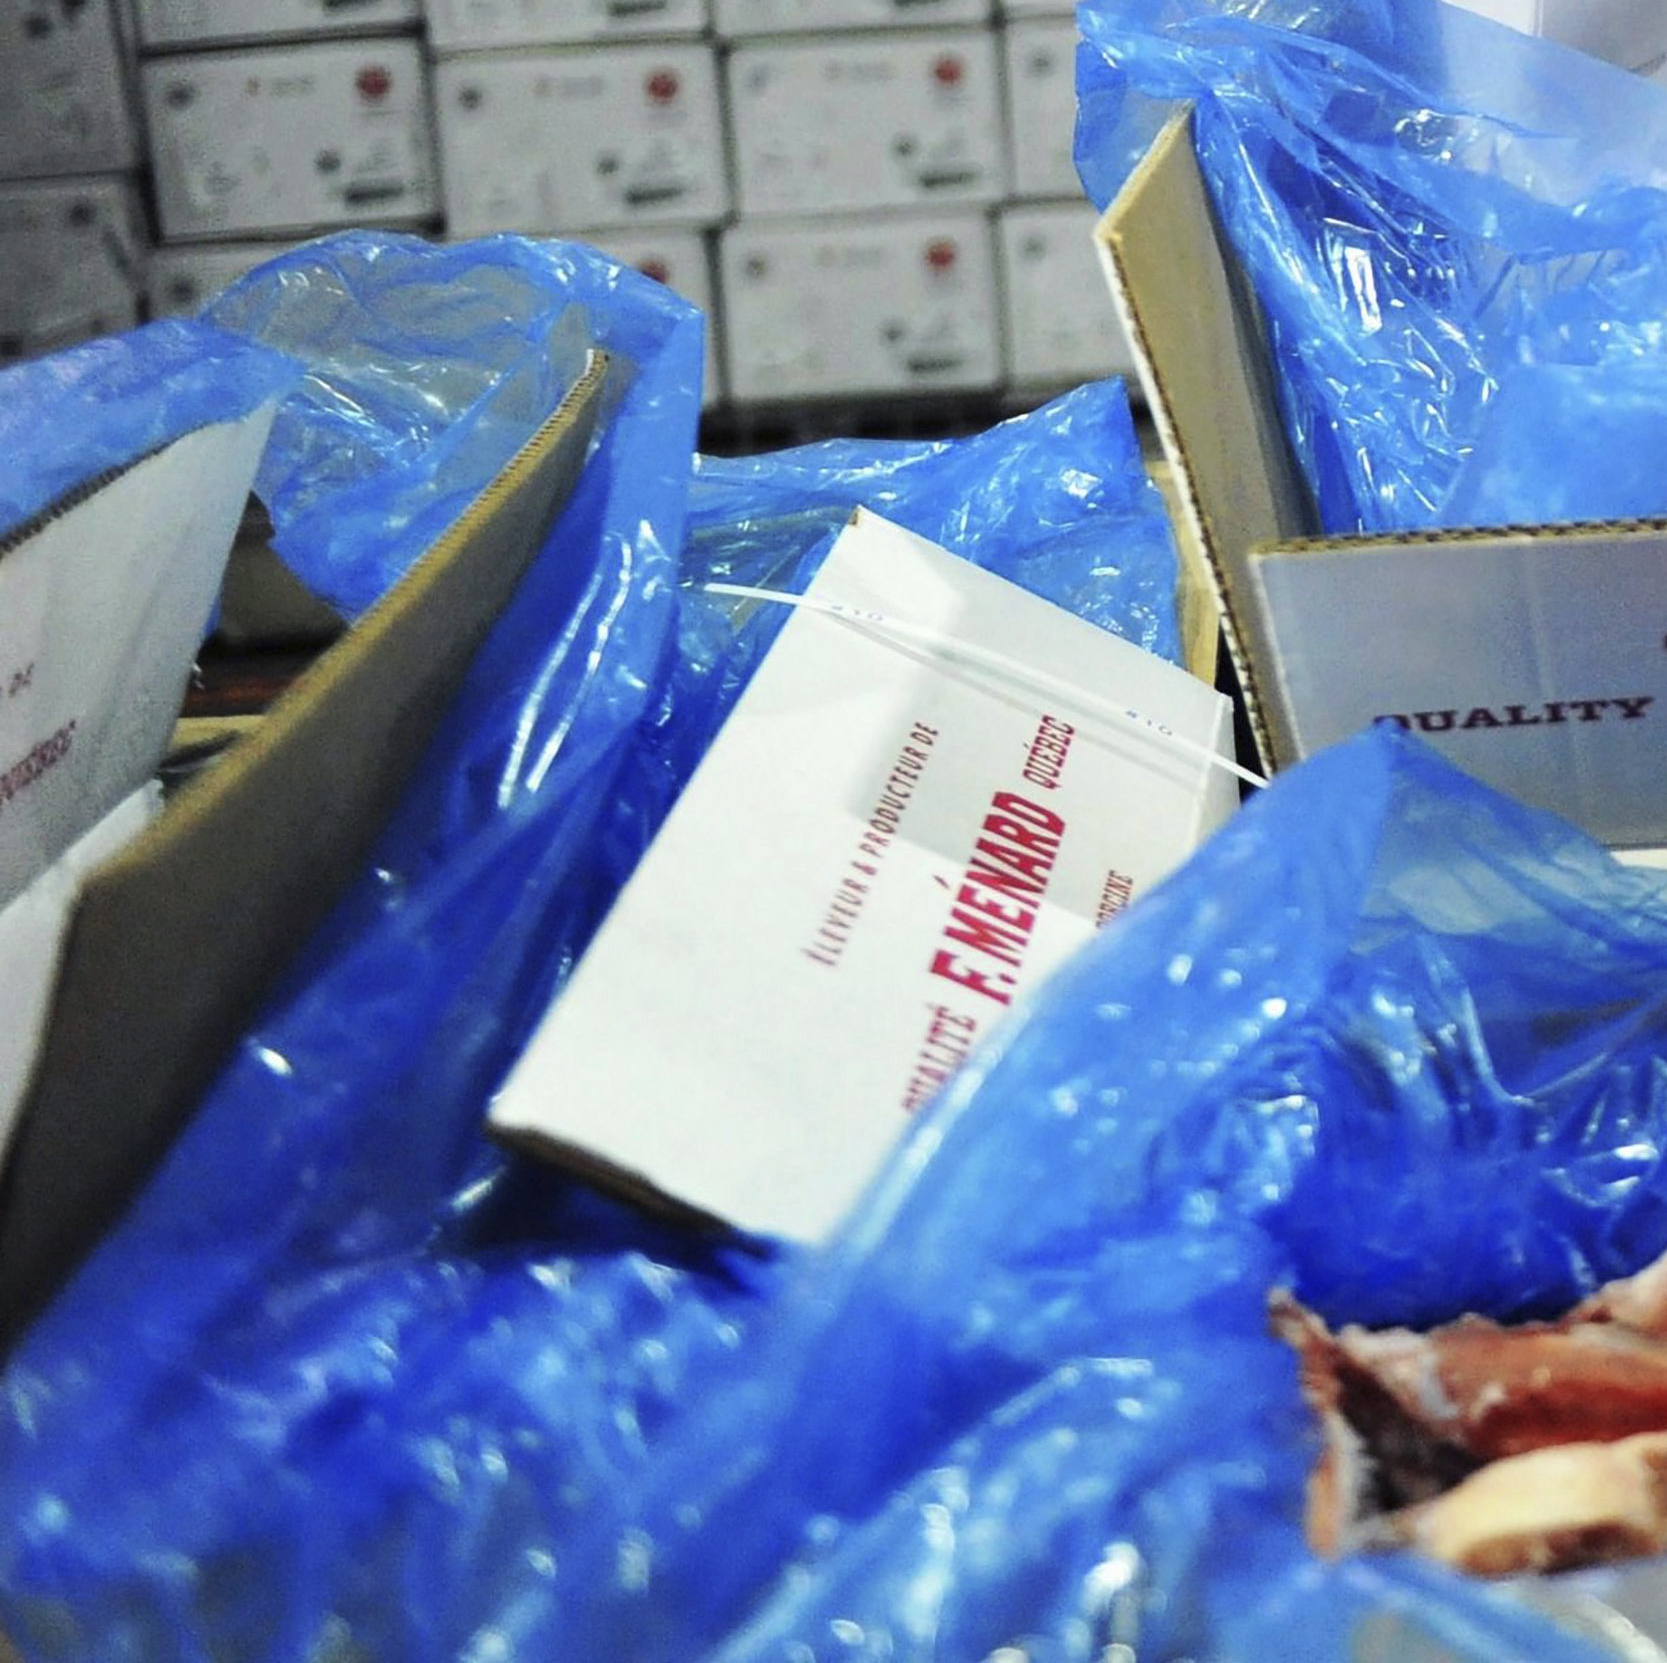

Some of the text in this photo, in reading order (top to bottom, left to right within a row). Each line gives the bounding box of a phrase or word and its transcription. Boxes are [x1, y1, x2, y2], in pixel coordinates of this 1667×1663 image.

[1021, 714, 1076, 792] QUÉBEC
[801, 876, 870, 967] ÉLEVEUR
[859, 745, 929, 859] PRODUCTEUR
[909, 721, 939, 748] DE
